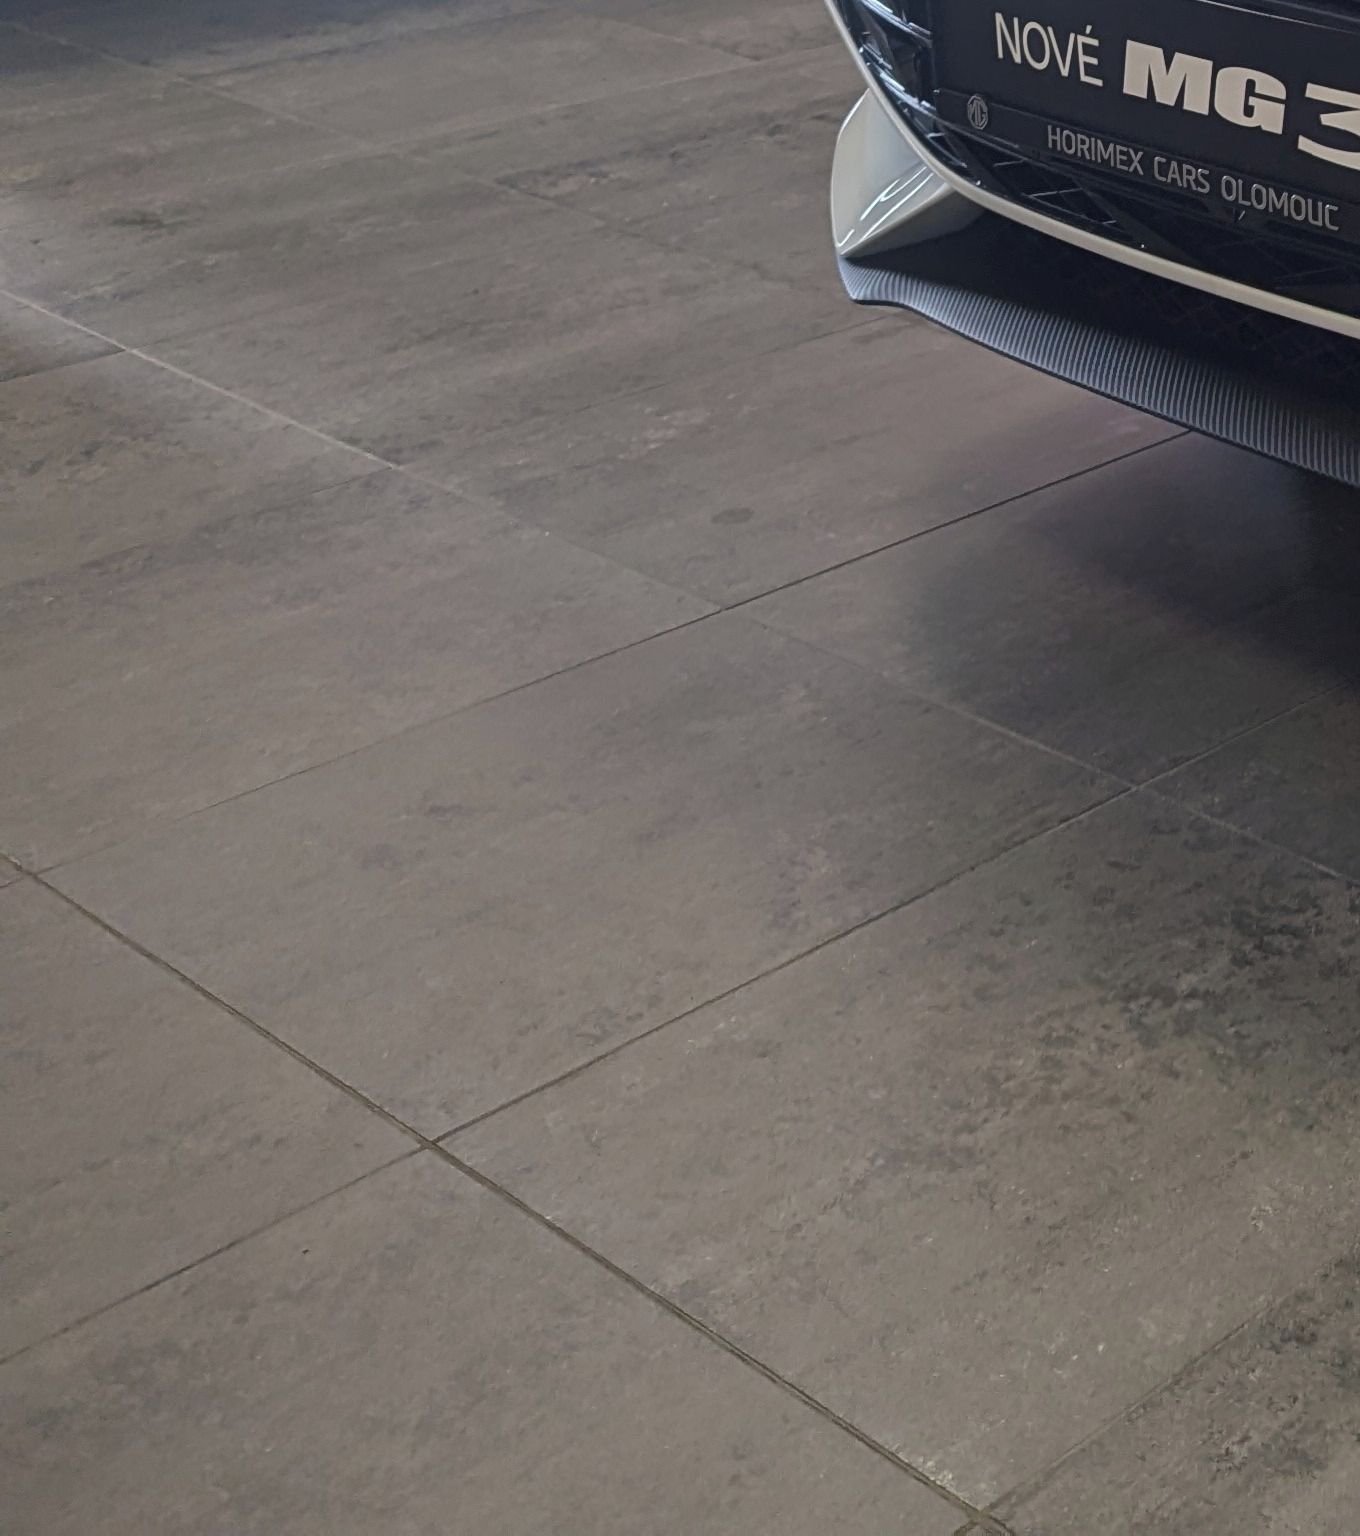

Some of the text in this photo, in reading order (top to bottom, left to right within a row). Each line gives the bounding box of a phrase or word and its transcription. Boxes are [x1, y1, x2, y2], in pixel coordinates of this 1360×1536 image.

[995, 11, 1104, 87] NOVÉ
[1047, 124, 1340, 233] HORIMEX CARS OLOMOUC
